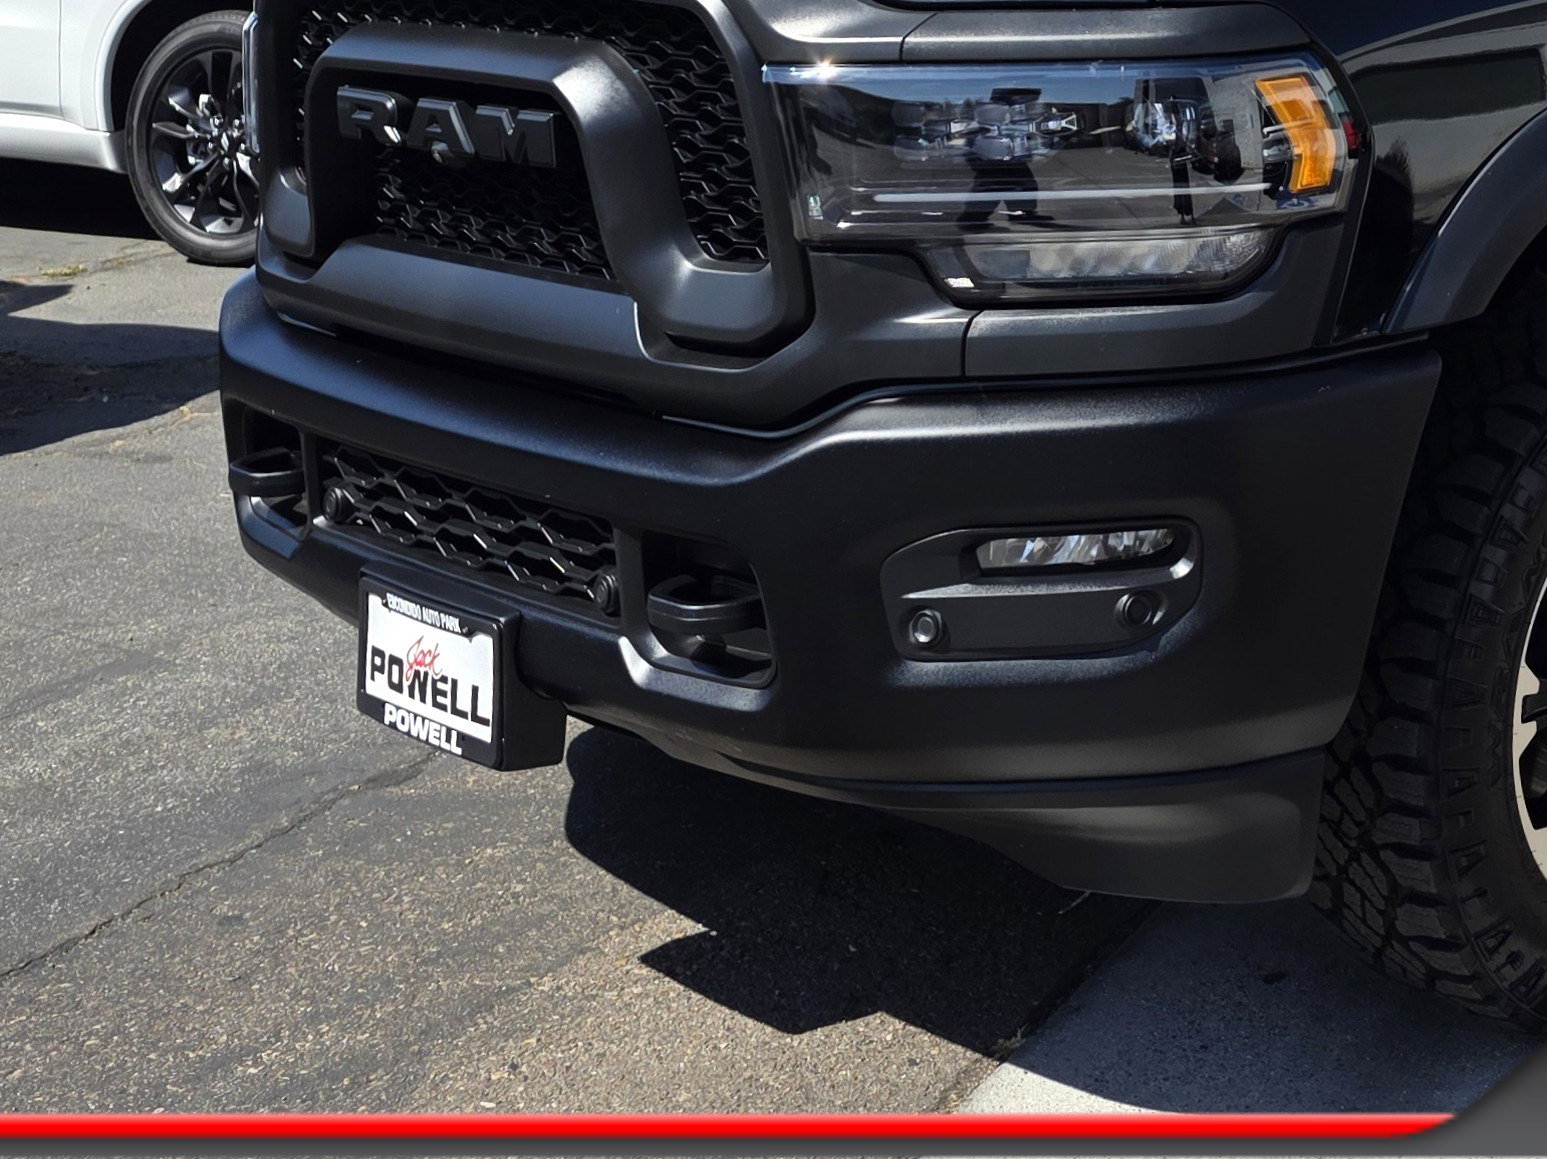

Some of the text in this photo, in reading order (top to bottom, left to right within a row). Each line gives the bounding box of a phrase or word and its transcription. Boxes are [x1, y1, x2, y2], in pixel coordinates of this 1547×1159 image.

[336, 85, 557, 168] RAM
[422, 606, 440, 627] AUTO
[440, 612, 461, 633] PARK
[405, 635, 443, 682] Jack
[370, 645, 491, 728] POWELL
[383, 702, 463, 756] POWELL
